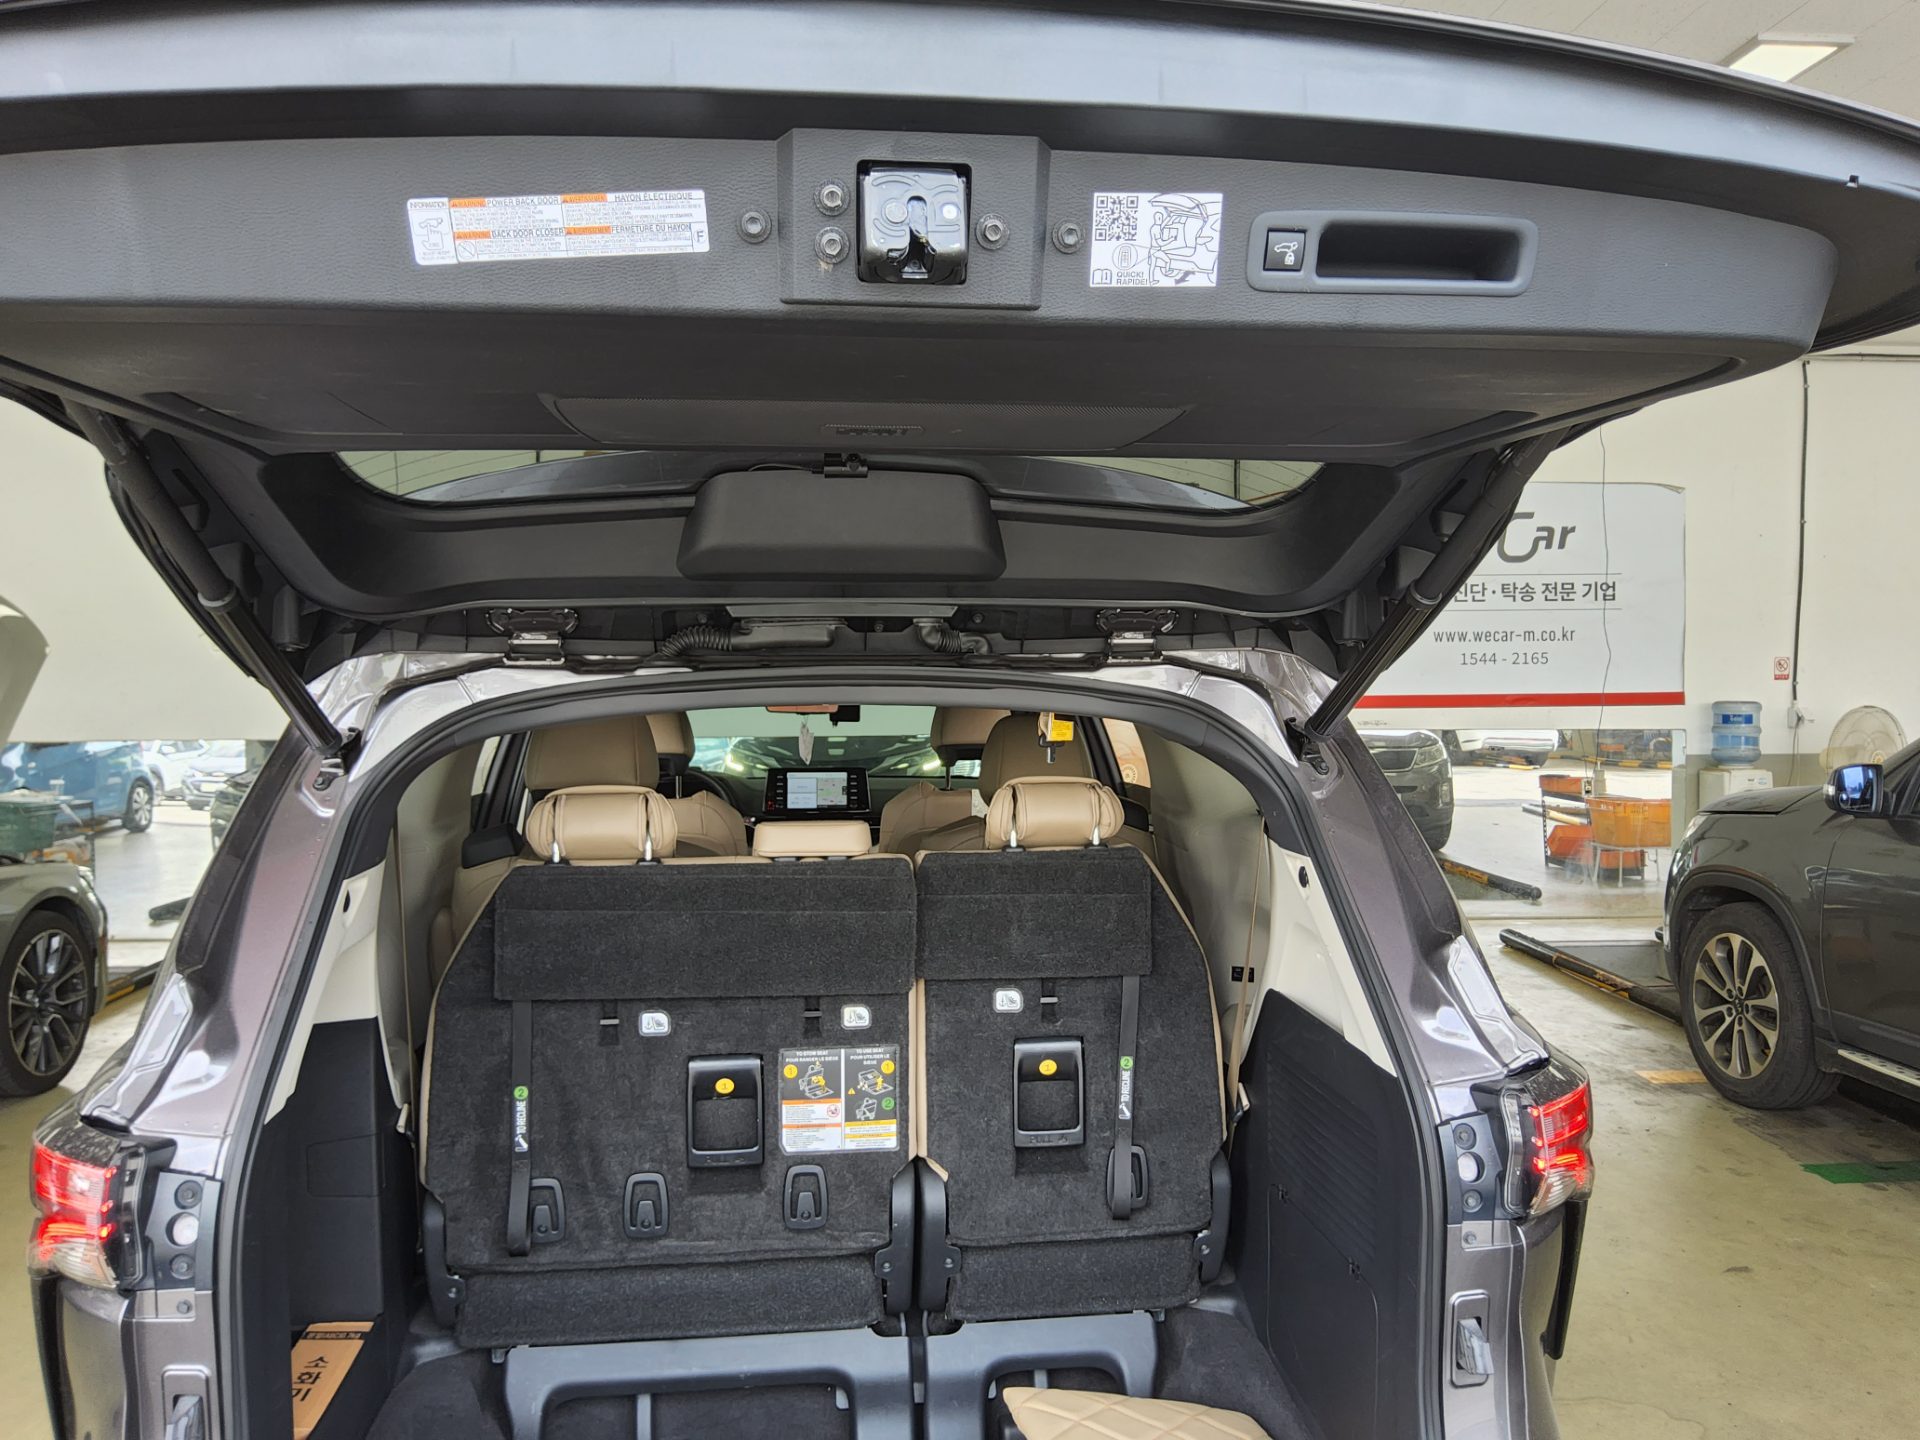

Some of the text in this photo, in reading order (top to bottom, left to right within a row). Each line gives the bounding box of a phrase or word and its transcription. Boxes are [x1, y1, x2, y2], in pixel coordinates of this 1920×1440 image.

[492, 230, 511, 238] BACK
[513, 229, 534, 237] DOOR
[536, 228, 564, 237] CLOSER
[612, 225, 654, 234] FERMETURE
[1541, 581, 1576, 602] 전문
[1582, 581, 1616, 602] 기업
[1433, 626, 1576, 643] www.wecar-m.co.kr
